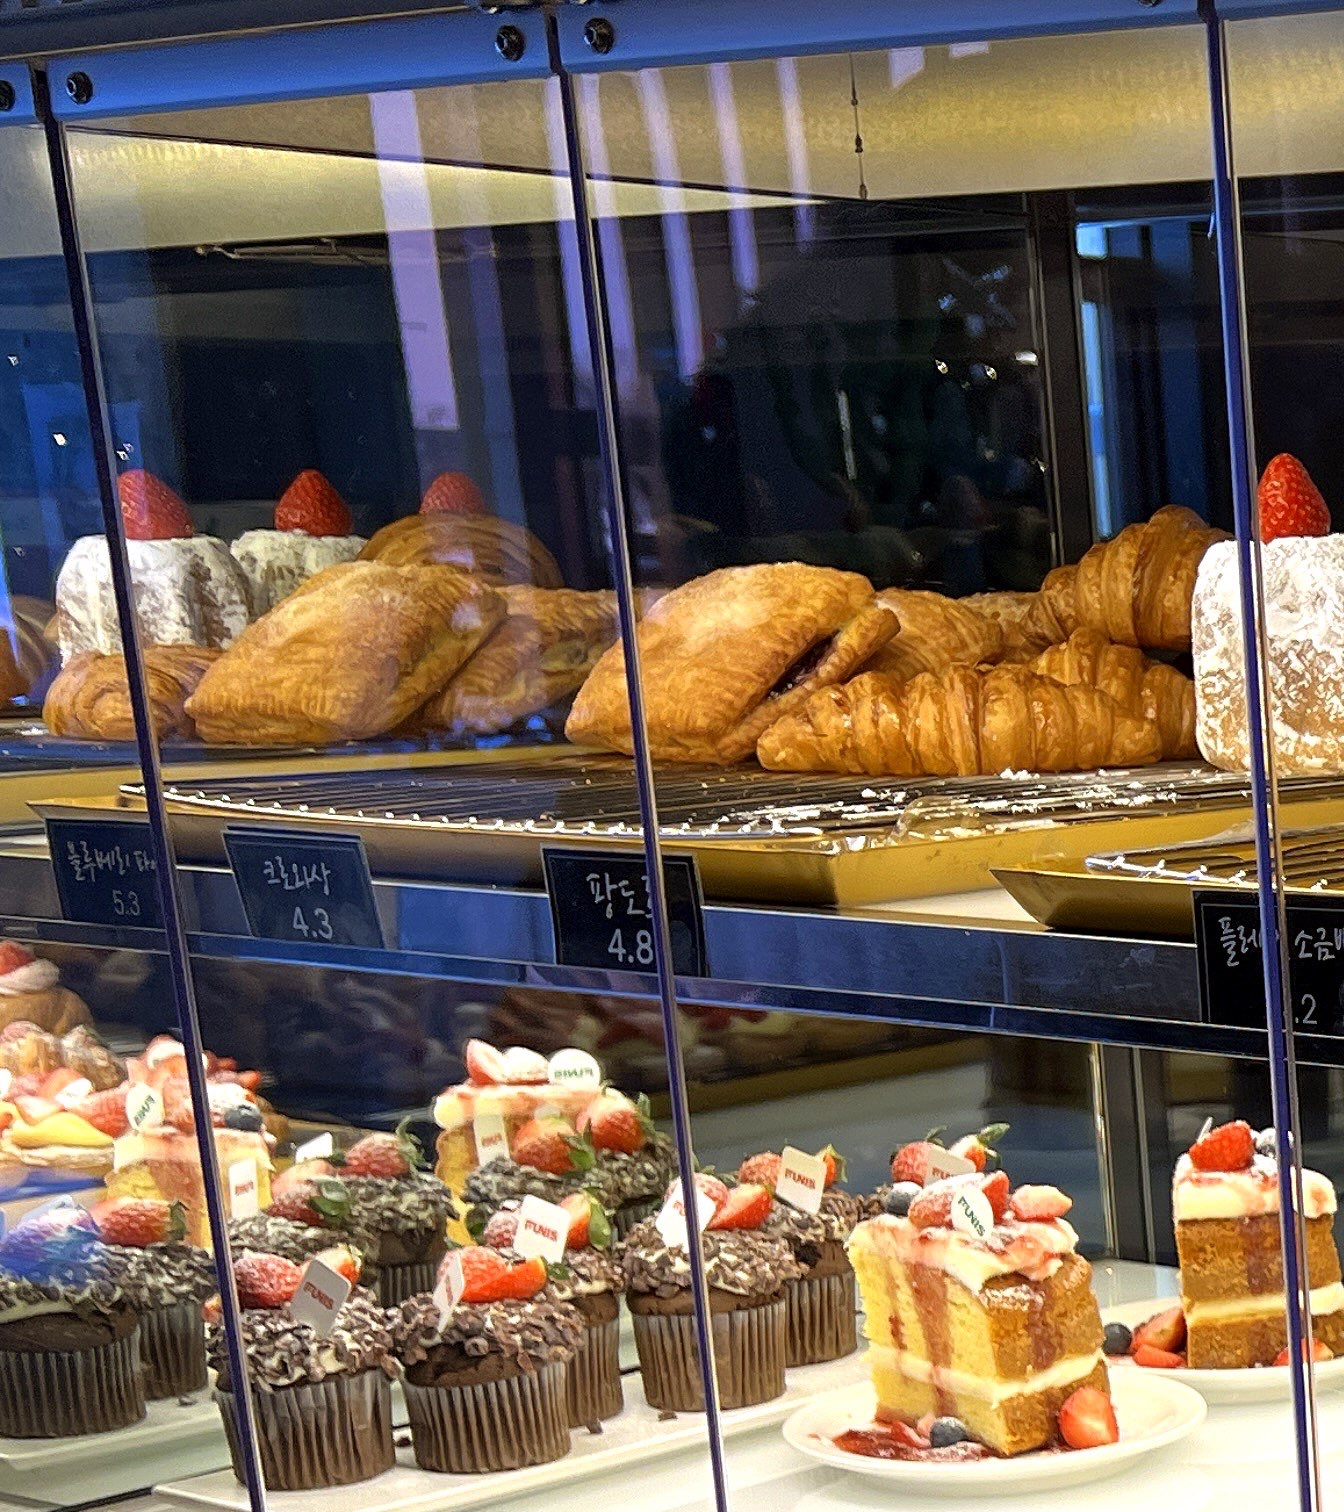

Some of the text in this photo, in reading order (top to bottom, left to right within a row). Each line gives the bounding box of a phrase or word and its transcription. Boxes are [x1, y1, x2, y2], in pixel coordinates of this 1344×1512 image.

[133, 849, 157, 873] 파
[112, 889, 141, 917] 5.3
[292, 906, 333, 940] 4.3
[608, 928, 654, 965] 4.8
[1218, 916, 1279, 967] 플레
[784, 1166, 816, 1190] FUNIS
[524, 1219, 559, 1243] FUNIS
[957, 1195, 986, 1237] FUNIS
